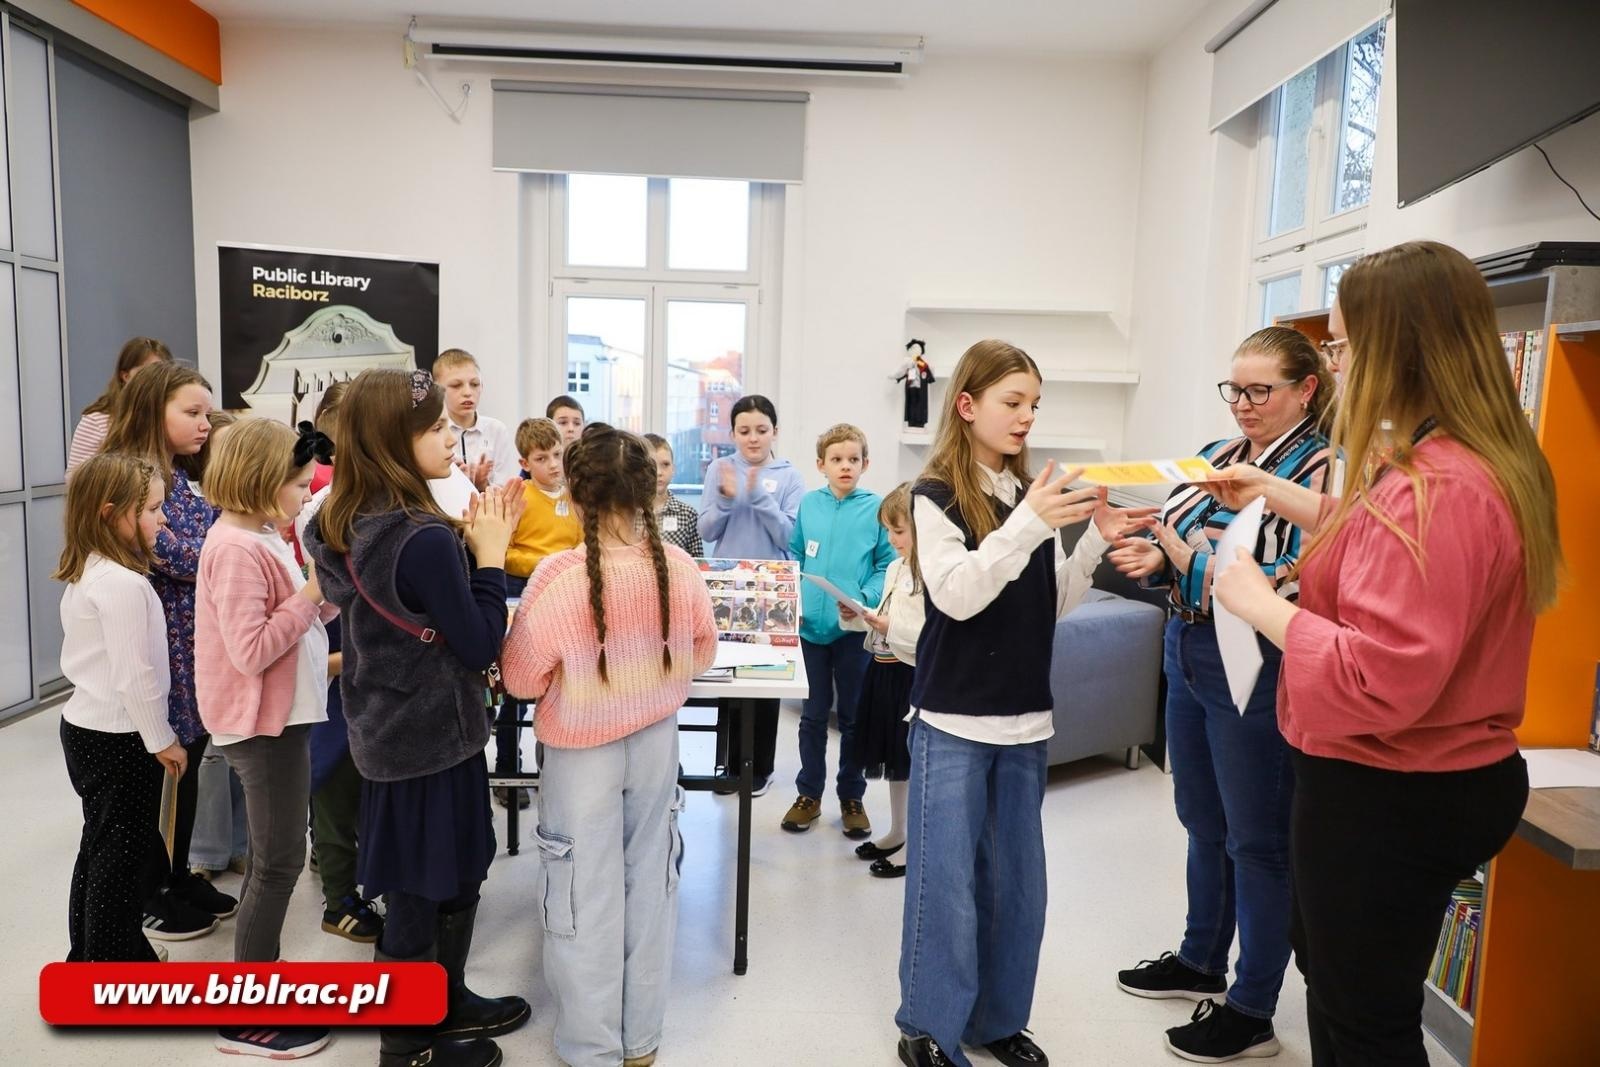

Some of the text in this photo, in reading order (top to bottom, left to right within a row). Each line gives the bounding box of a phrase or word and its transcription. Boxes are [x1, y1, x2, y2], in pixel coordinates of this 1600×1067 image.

[252, 266, 371, 292] Public Library
[252, 283, 330, 302] Raciborz
